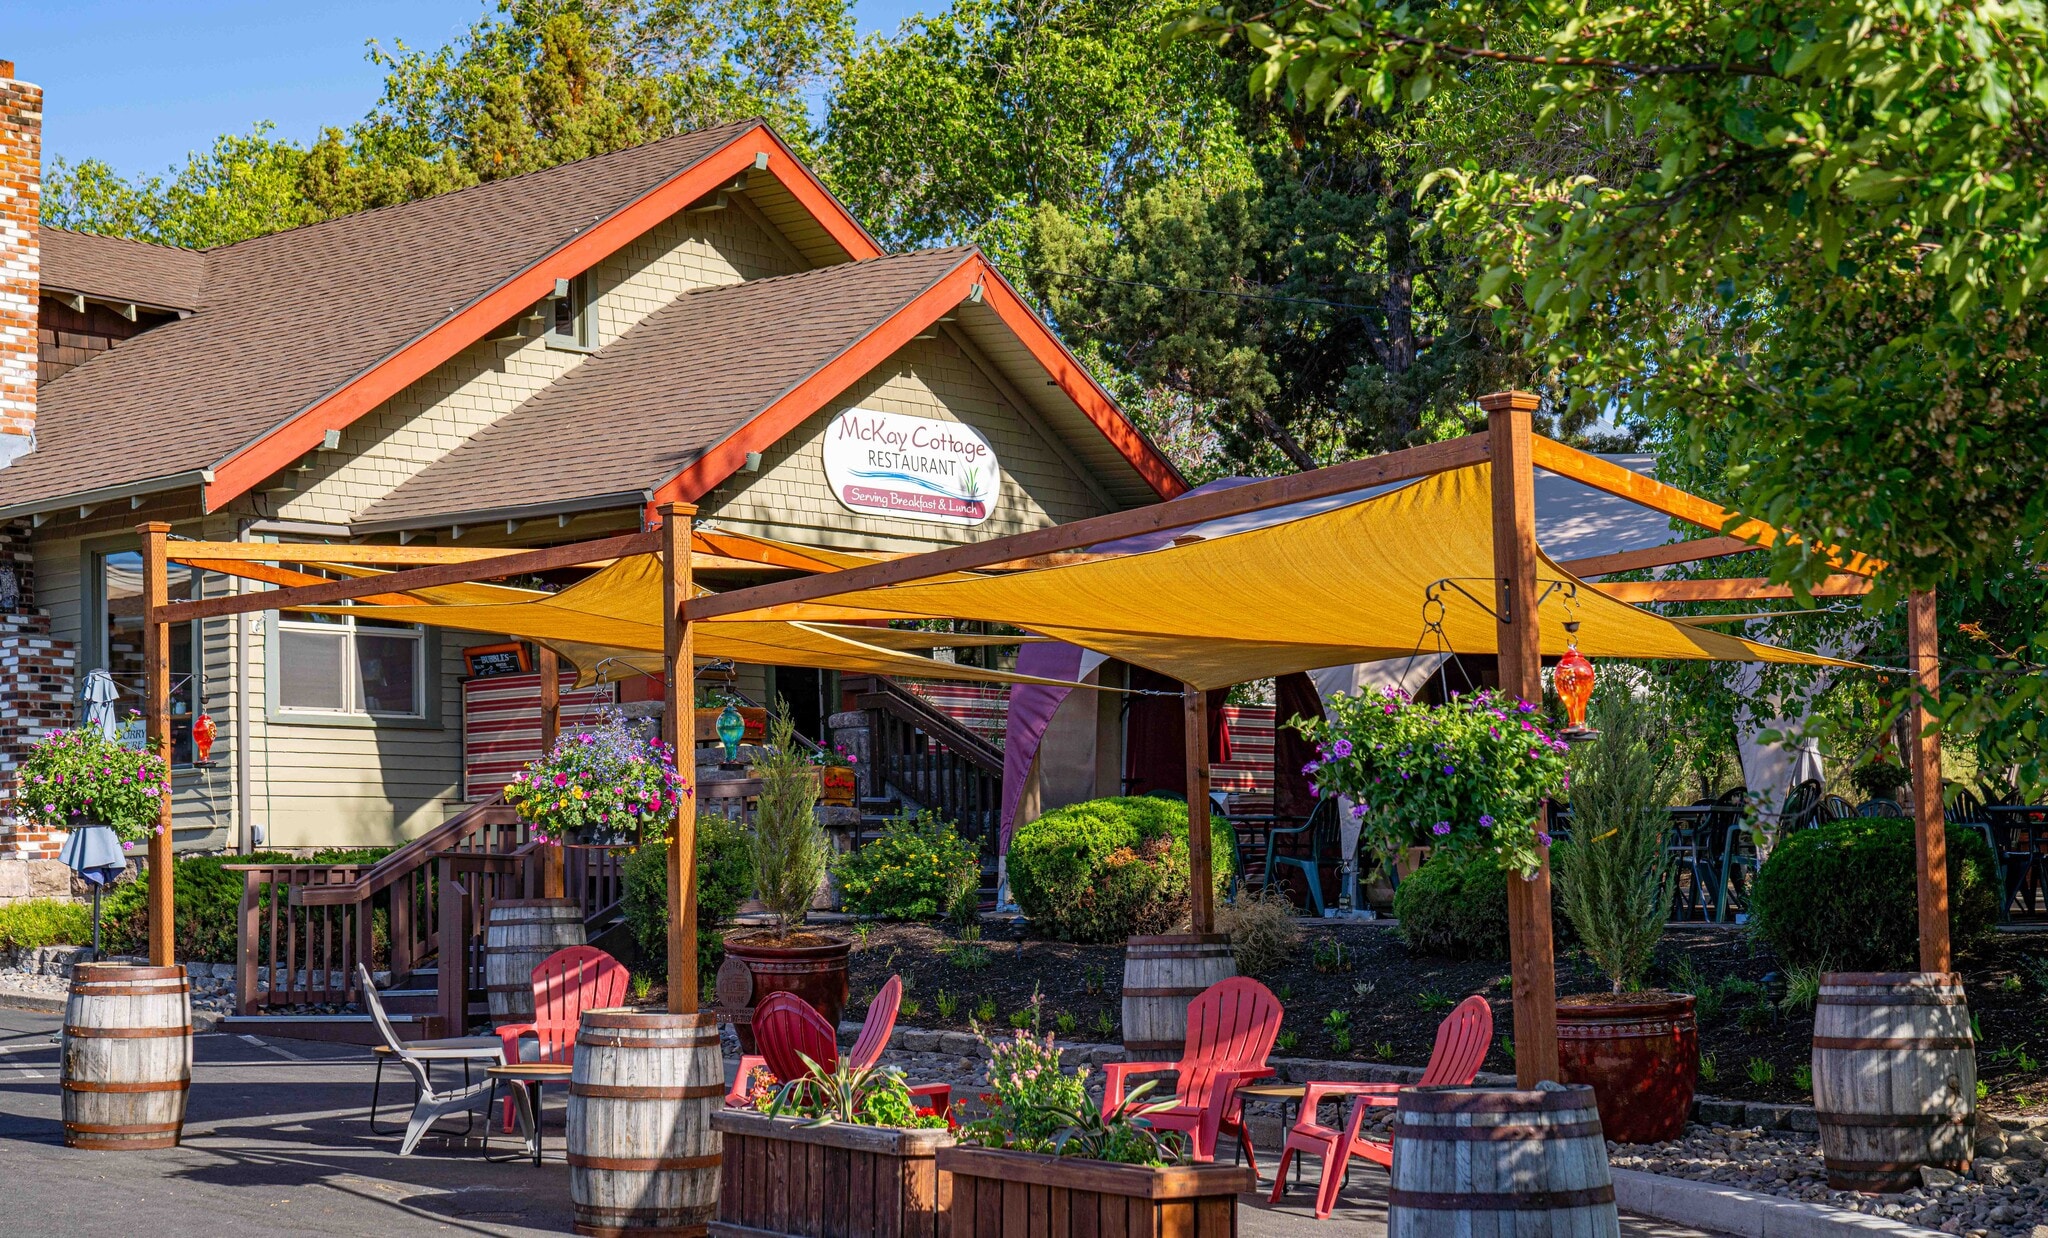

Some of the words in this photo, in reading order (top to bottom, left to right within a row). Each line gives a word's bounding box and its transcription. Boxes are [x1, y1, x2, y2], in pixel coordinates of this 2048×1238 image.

[838, 414, 908, 451] McKay
[912, 426, 987, 463] Cottage
[868, 450, 956, 476] RESTAURANT
[851, 488, 888, 507] Serving
[890, 492, 936, 511] Breakfast
[938, 499, 946, 509] &
[948, 499, 978, 515] Lunch
[119, 729, 146, 740] ORRY
